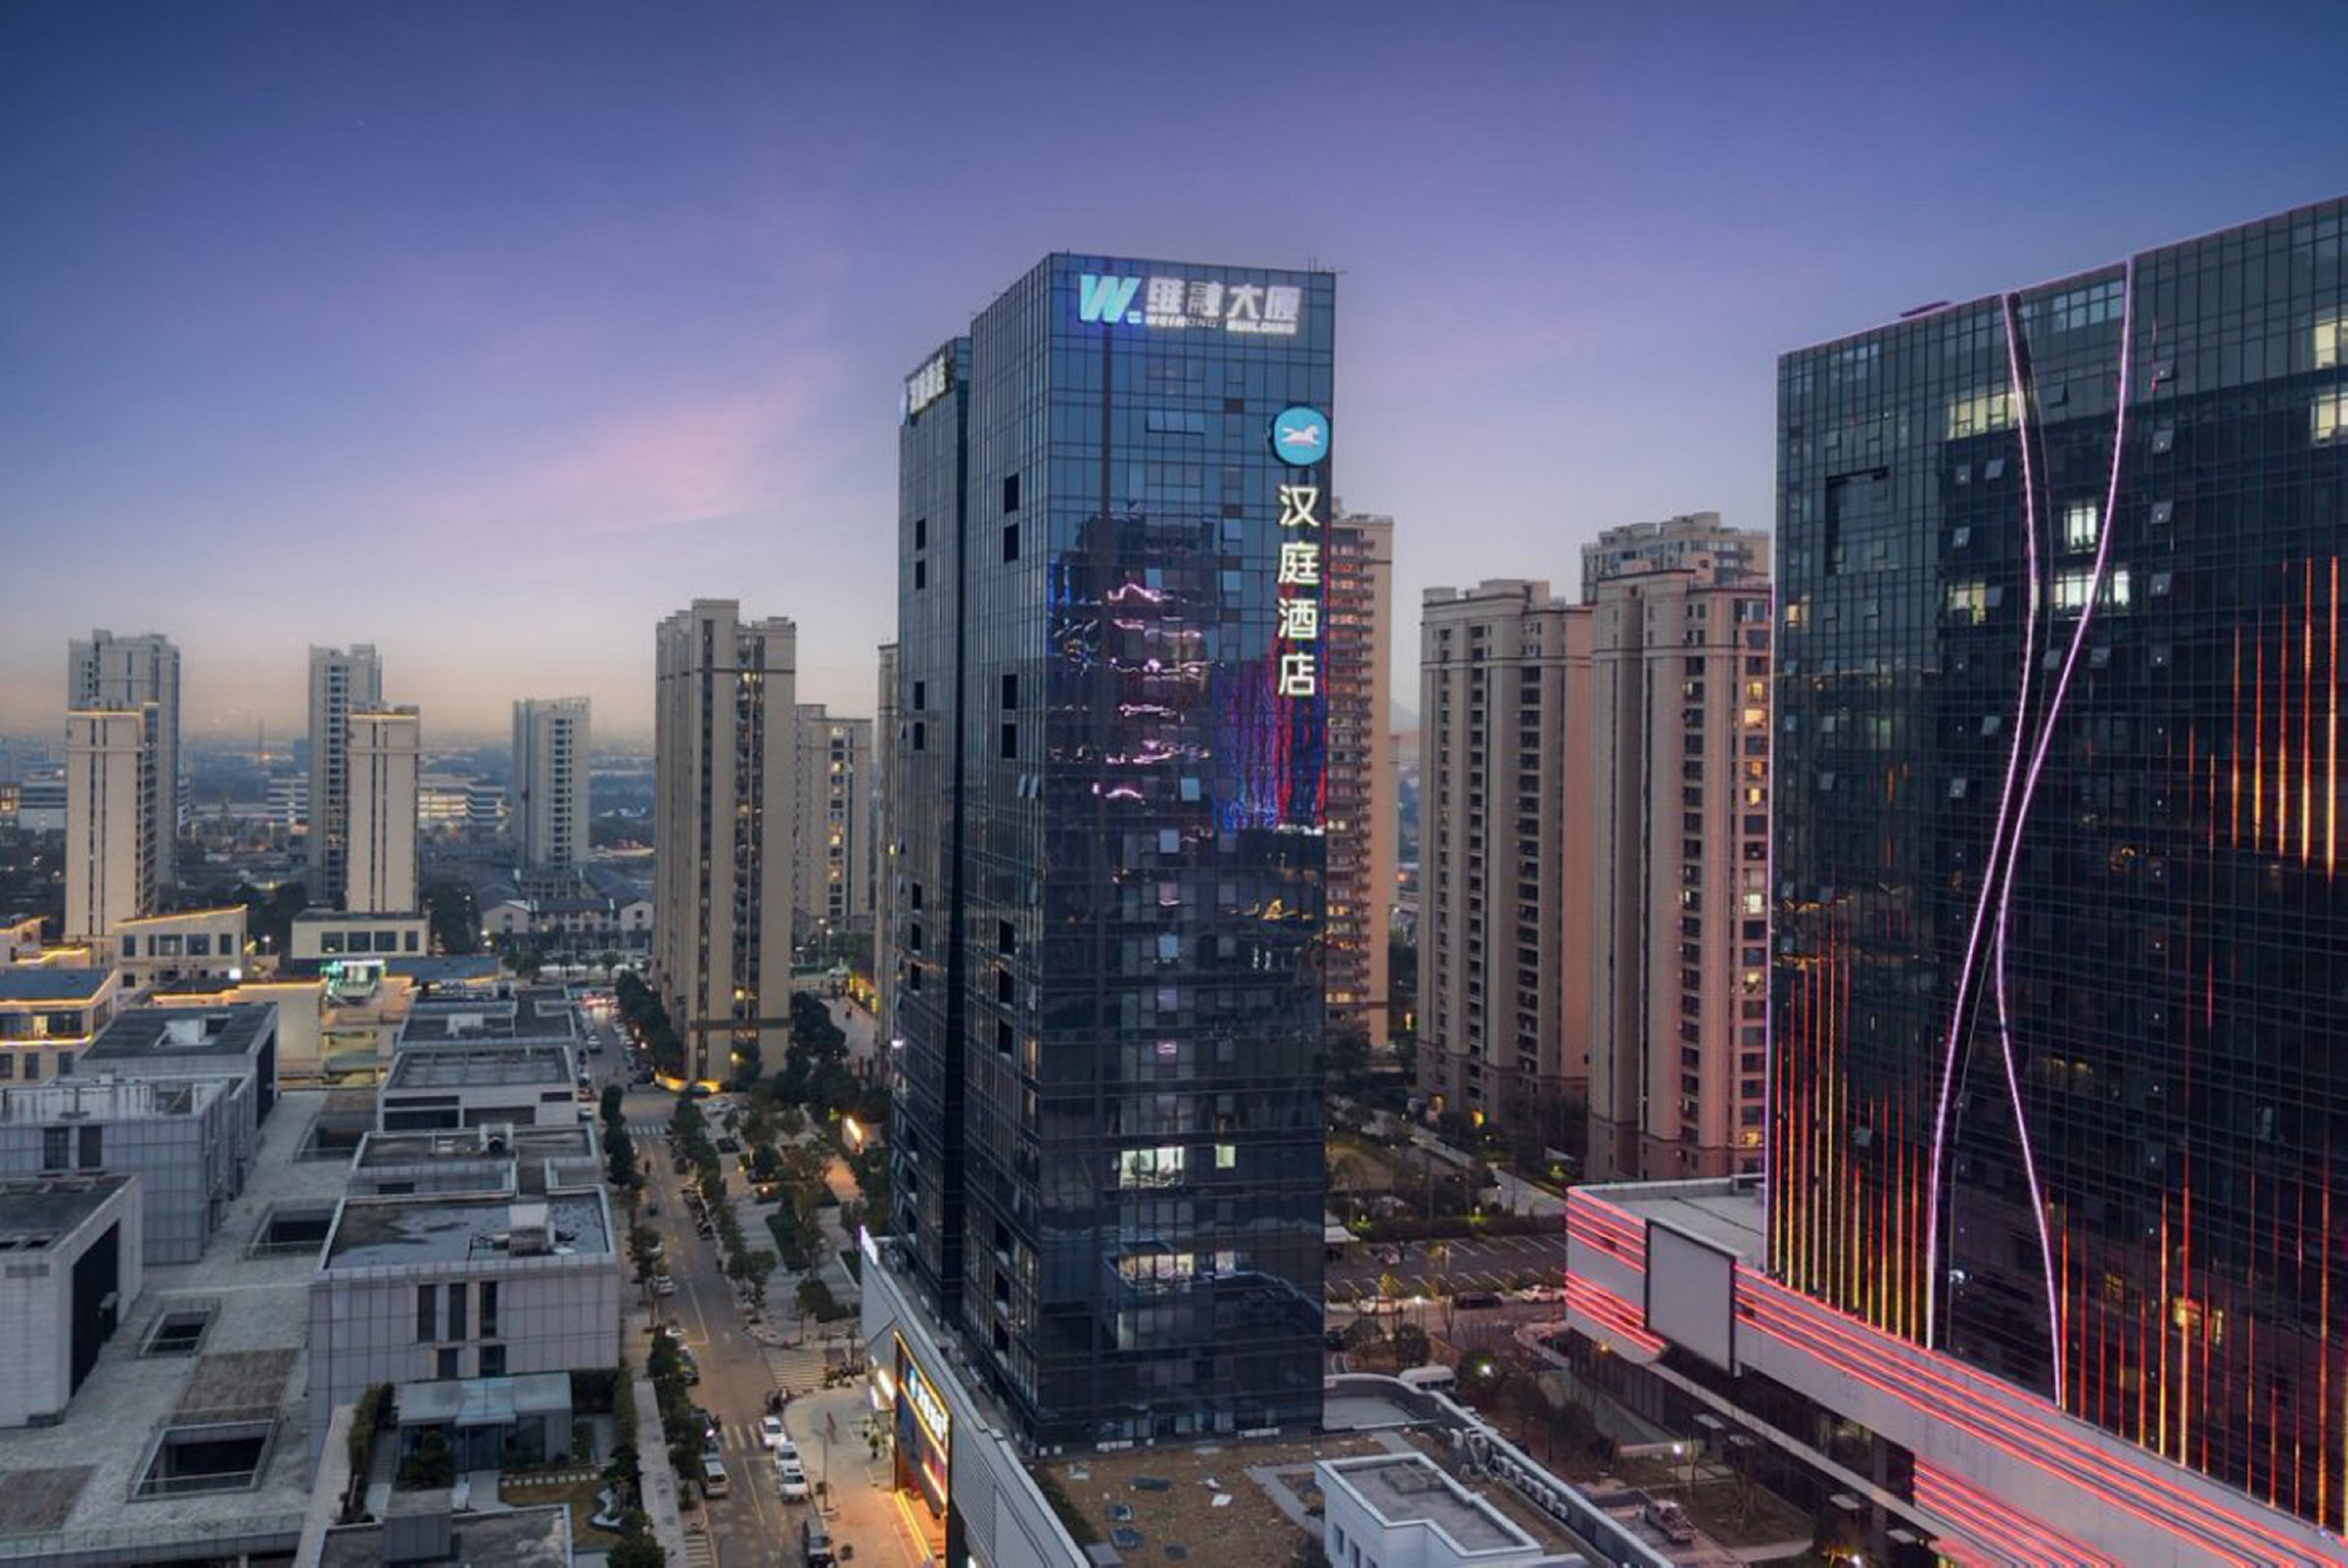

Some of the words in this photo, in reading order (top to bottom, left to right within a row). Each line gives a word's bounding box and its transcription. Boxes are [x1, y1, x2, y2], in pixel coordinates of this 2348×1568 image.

[1226, 320, 1297, 335] BUILDING
[1278, 484, 1320, 695] 汉庭酒店
